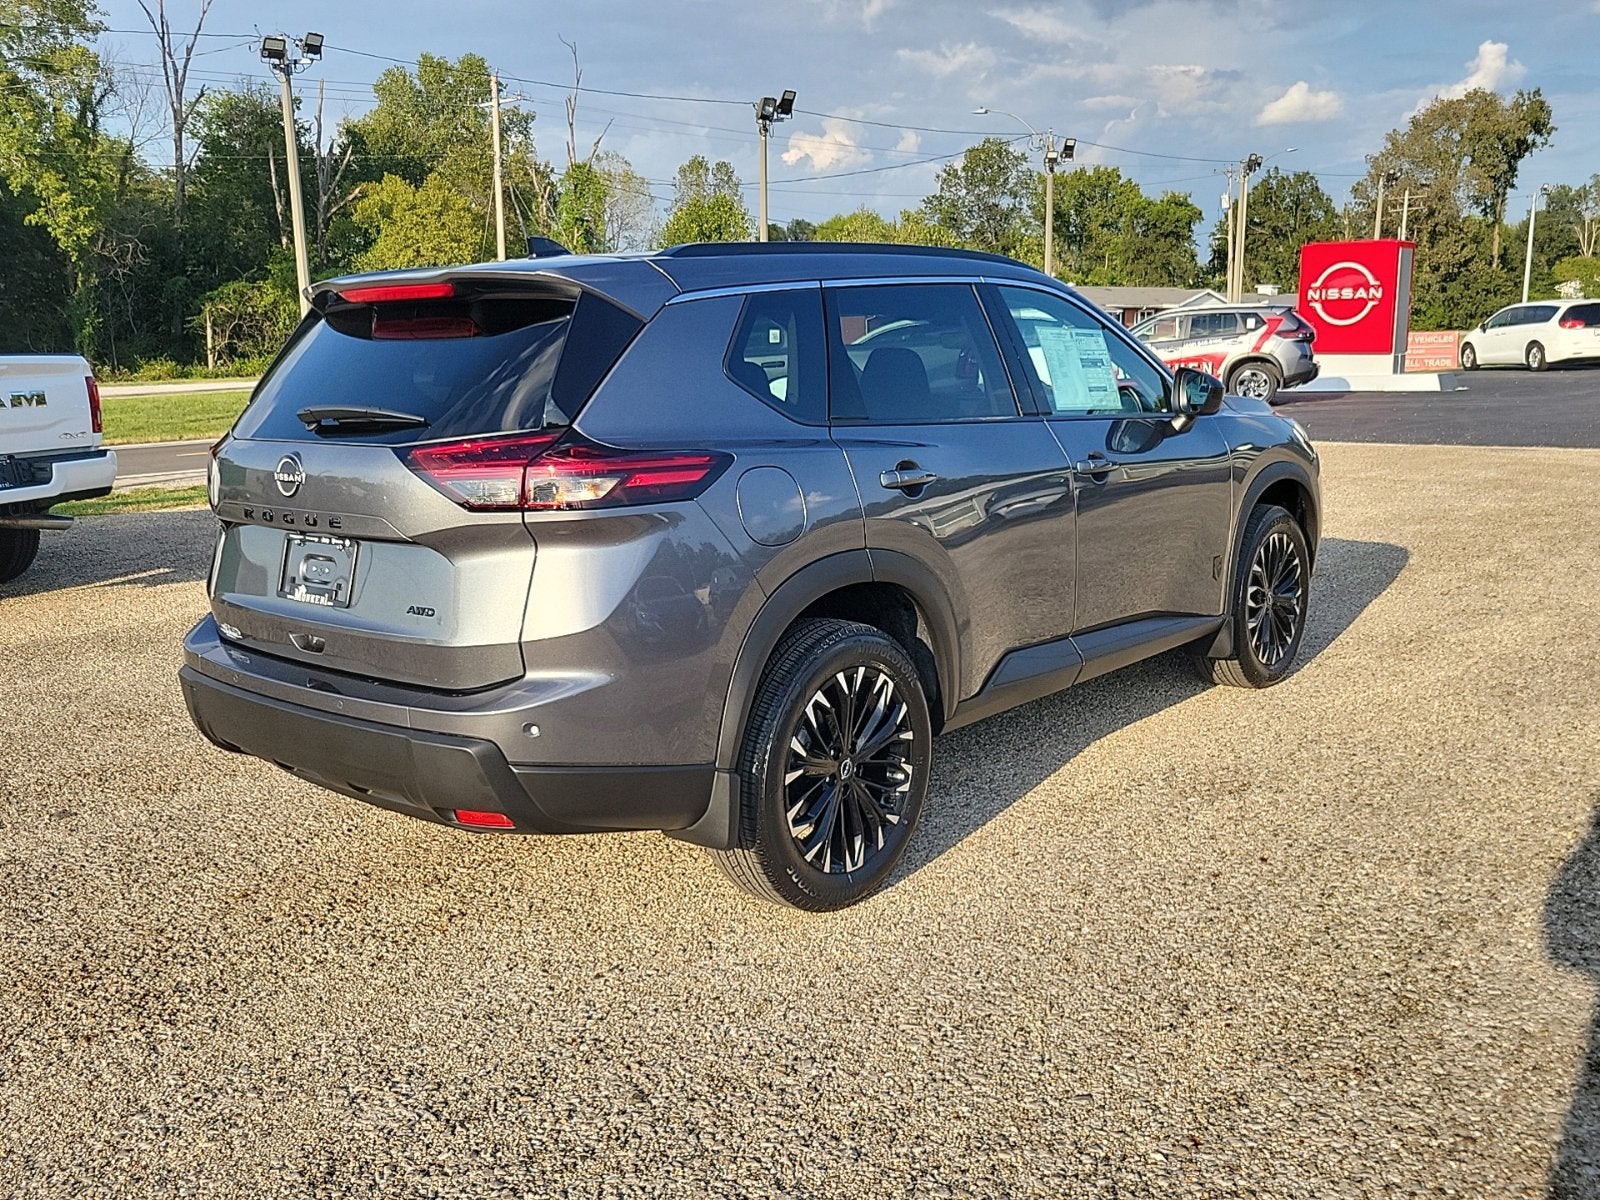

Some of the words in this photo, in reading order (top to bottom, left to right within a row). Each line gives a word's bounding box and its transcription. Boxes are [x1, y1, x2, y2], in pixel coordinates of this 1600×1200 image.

[1307, 286, 1383, 300] NISSAN
[1414, 335, 1454, 344] VEHICLES
[1423, 358, 1452, 368] TRADE
[243, 507, 343, 529] ROGUE
[406, 605, 436, 618] AWD
